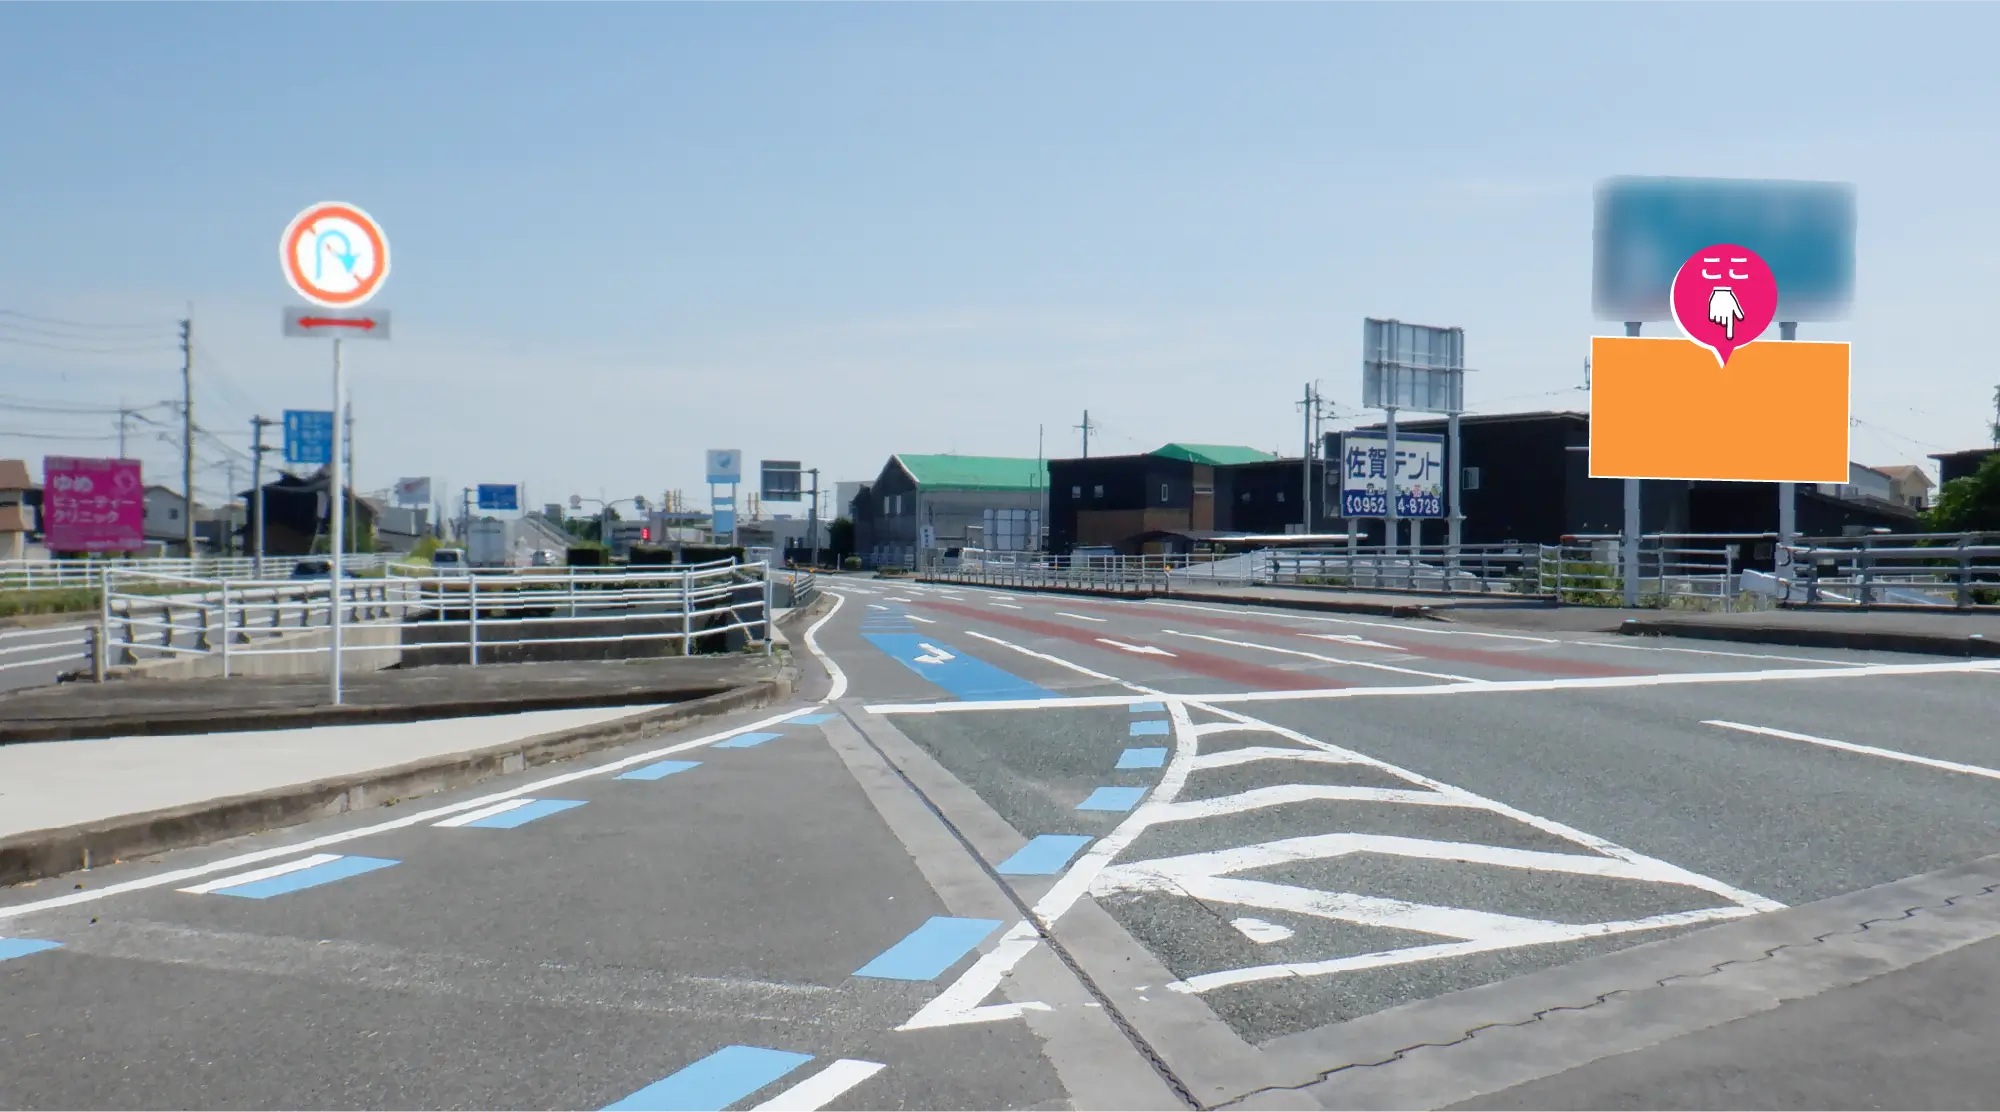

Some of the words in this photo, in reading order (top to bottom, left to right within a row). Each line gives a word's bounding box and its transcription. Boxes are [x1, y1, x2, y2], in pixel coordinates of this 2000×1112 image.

[1346, 446, 1440, 480] 佐賀テント
